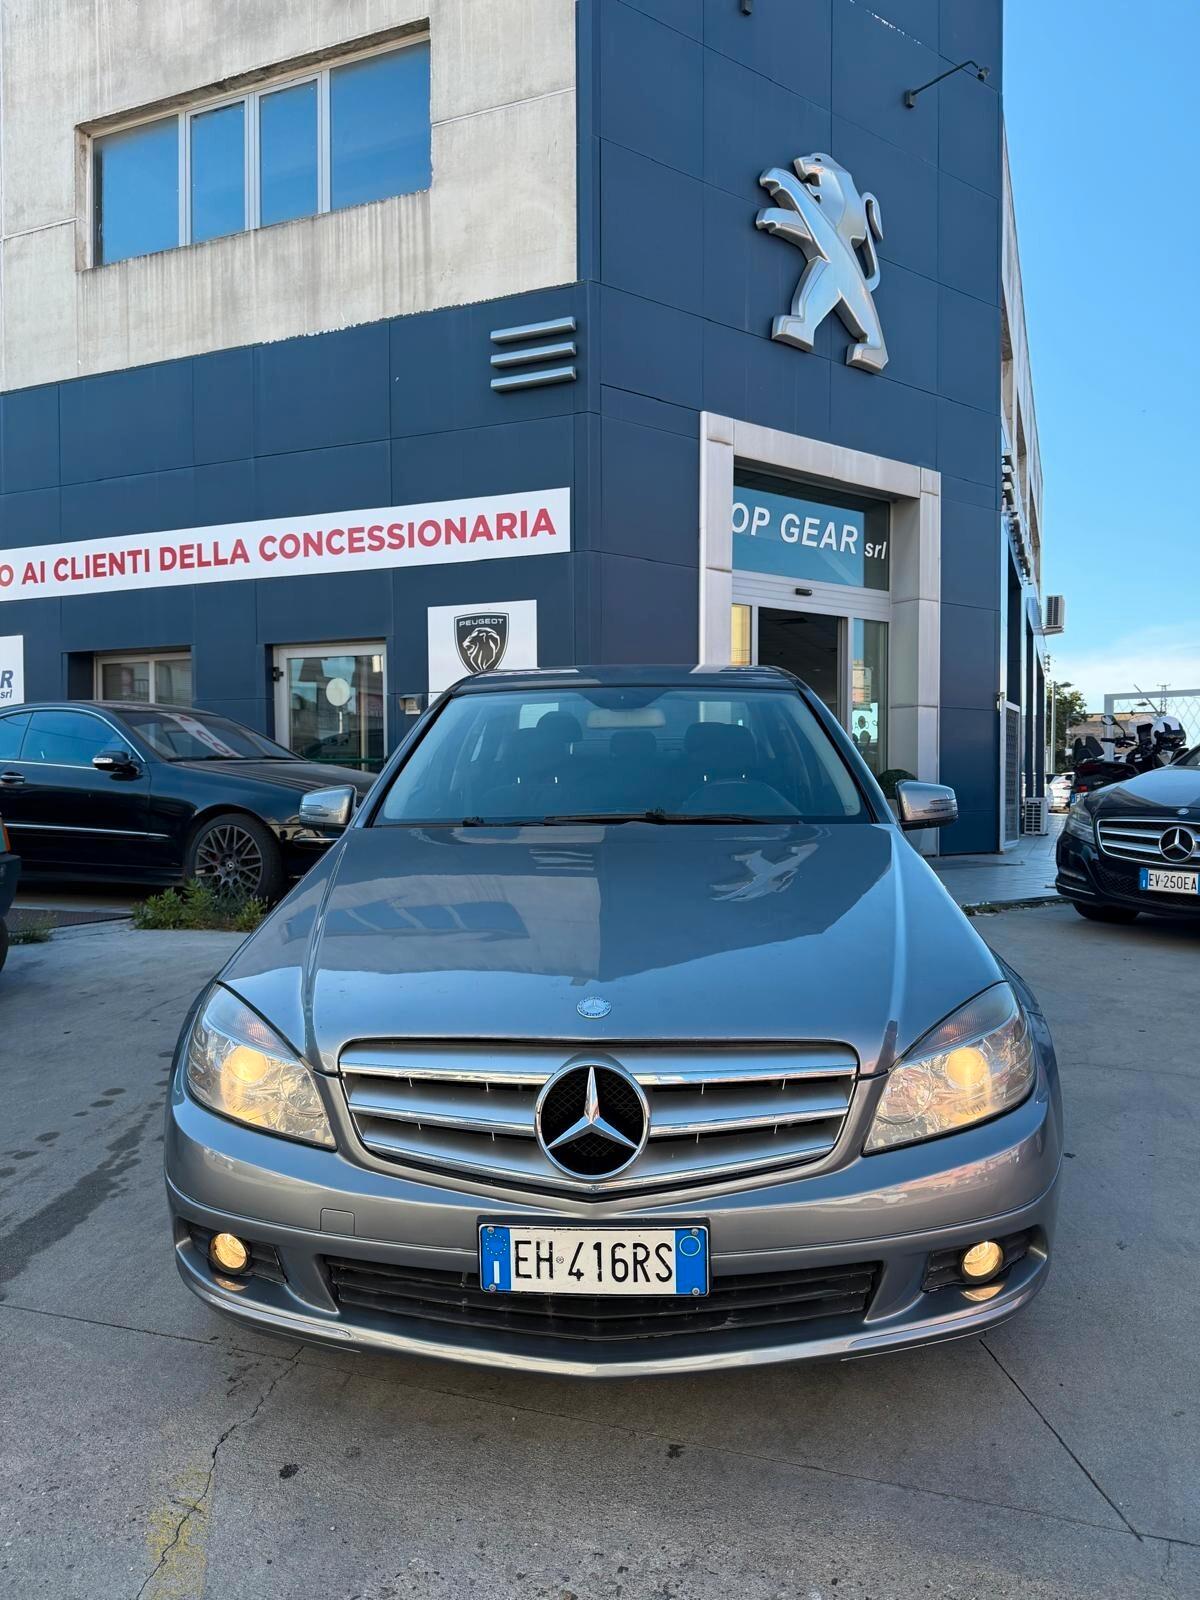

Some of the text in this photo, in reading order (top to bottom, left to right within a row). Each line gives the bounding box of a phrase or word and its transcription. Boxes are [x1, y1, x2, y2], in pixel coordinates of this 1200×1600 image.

[22, 561, 45, 584] AI
[53, 548, 150, 582] CLIENTI
[160, 539, 249, 571] DELLA
[259, 508, 556, 562] CONCESSIONARIA
[780, 513, 858, 554] GEAR
[864, 541, 887, 560] srl
[459, 618, 504, 627] PEUGEOT
